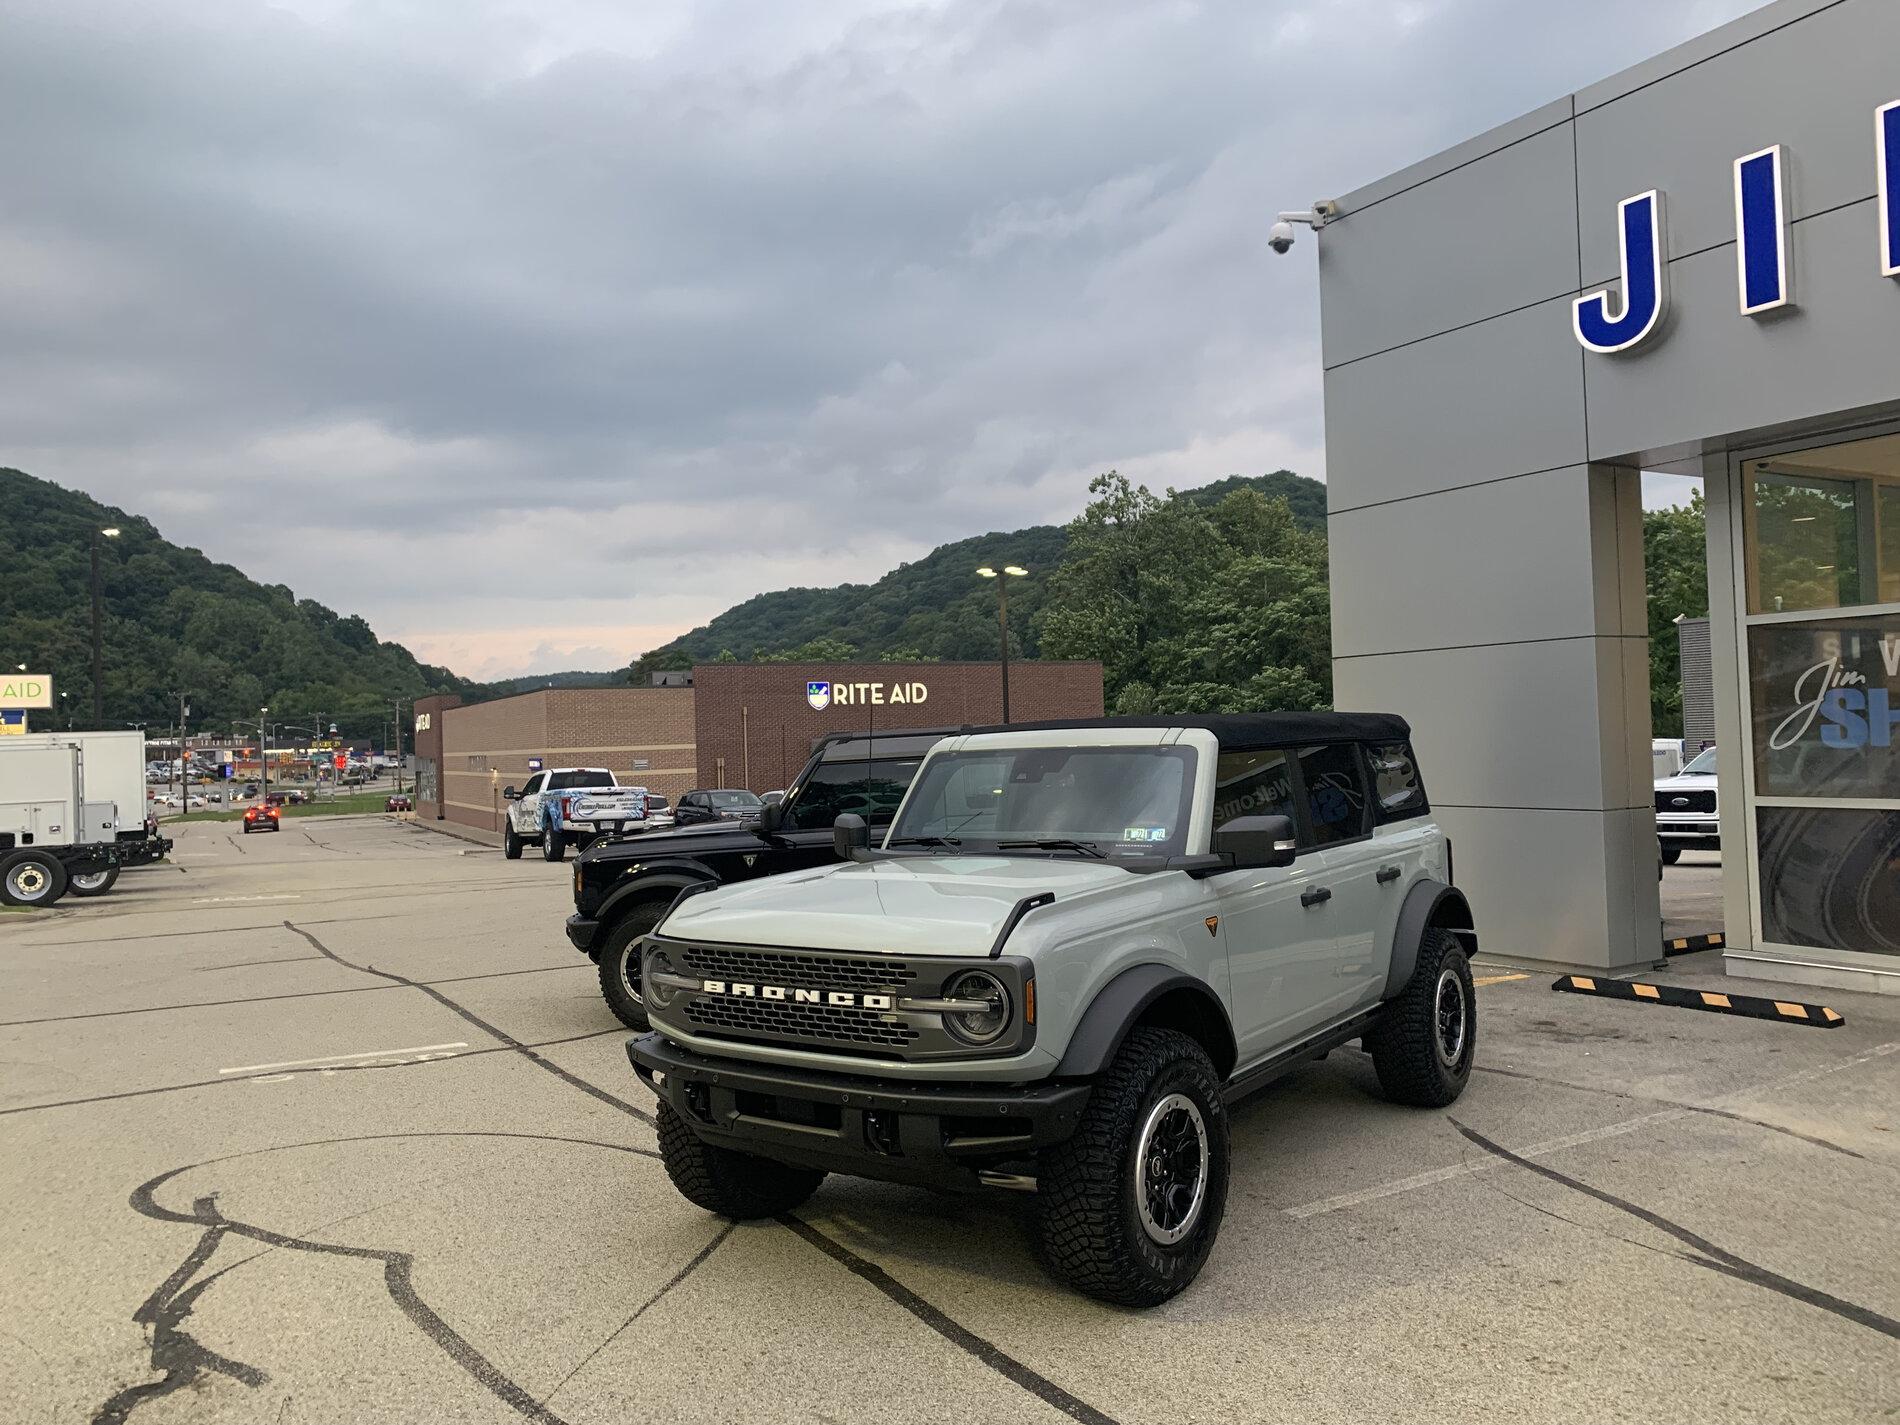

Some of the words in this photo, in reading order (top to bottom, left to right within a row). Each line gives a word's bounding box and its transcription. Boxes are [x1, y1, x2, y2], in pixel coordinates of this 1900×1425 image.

[3, 682, 42, 698] AID
[833, 683, 884, 705] RITE
[890, 682, 928, 704] AID
[1770, 657, 1866, 750] Jim
[703, 979, 891, 1009] BRONCO
